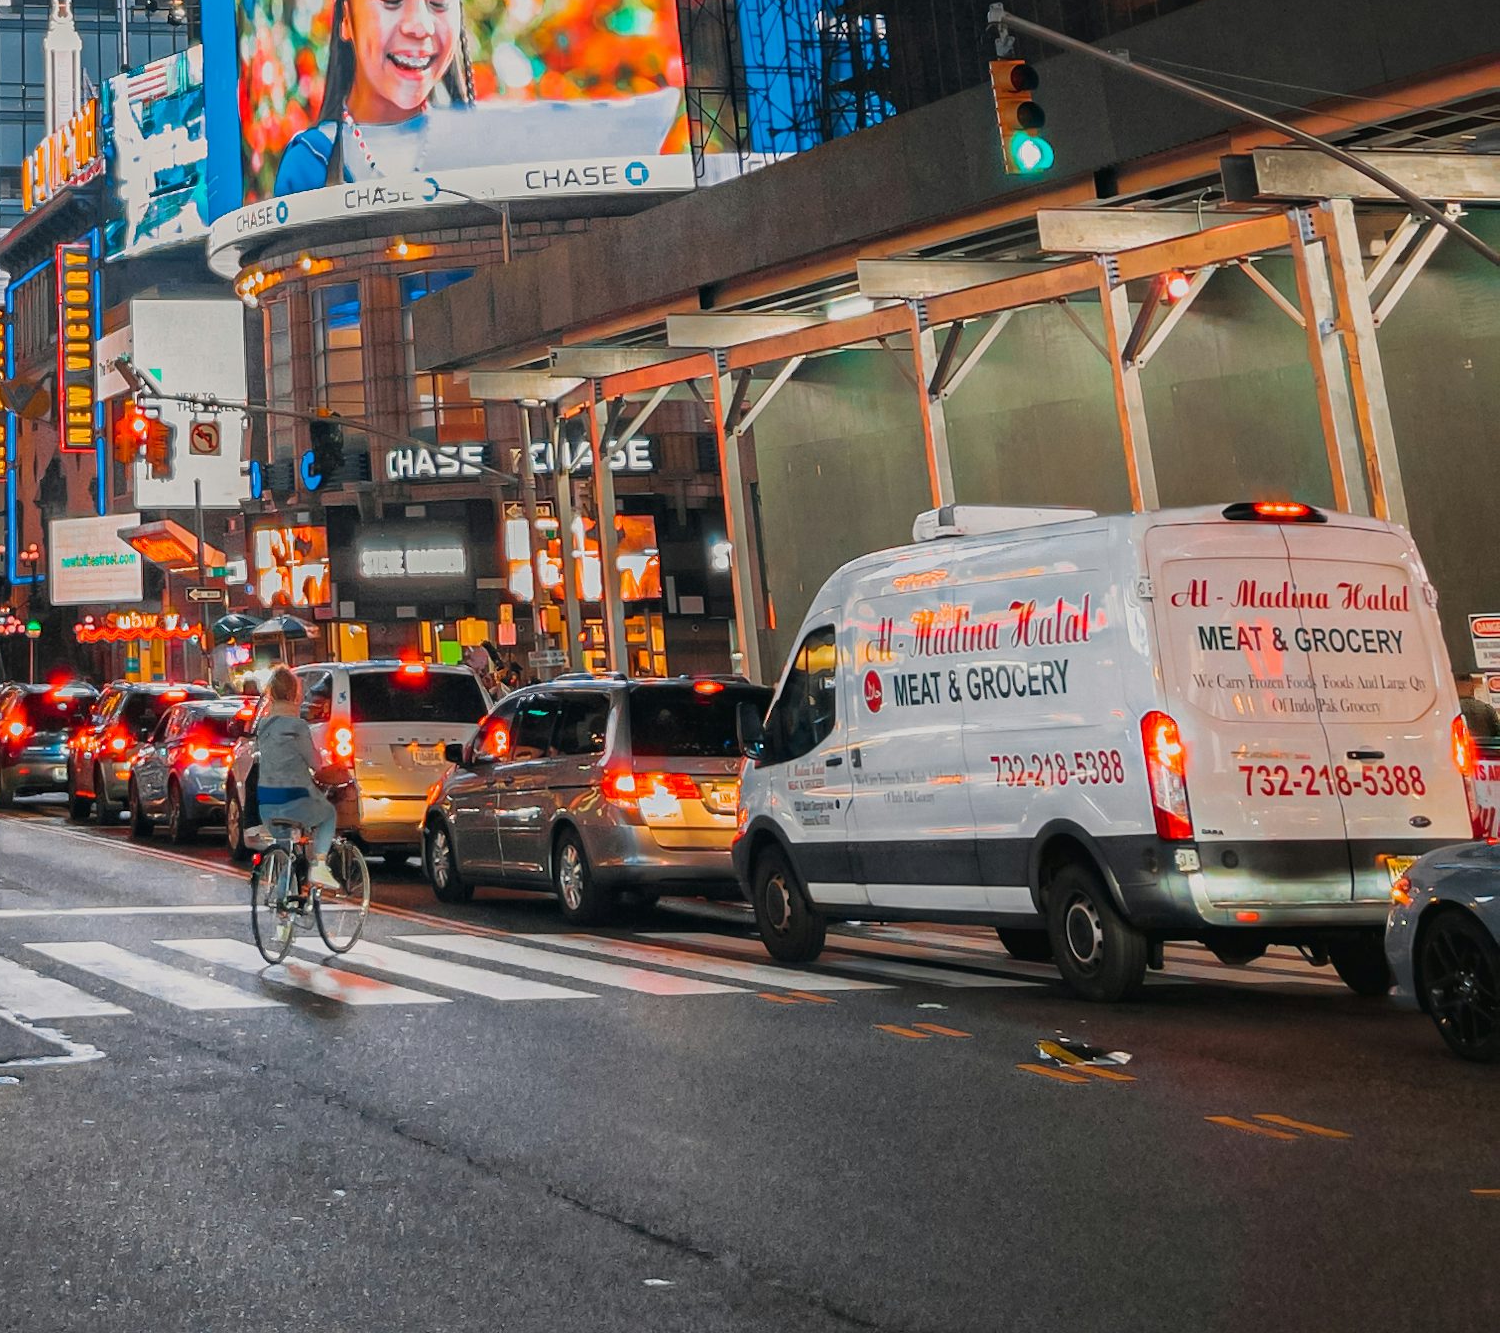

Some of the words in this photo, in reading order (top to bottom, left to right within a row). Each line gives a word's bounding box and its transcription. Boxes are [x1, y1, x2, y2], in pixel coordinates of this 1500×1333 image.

[525, 165, 618, 189] CHASE
[236, 205, 276, 234] CHASE
[64, 252, 93, 373] VICTORY
[66, 385, 94, 446] NEW
[385, 445, 485, 480] CHASE
[1171, 579, 1209, 607] Al
[1230, 579, 1331, 609] Madina
[1337, 582, 1411, 612] Halal
[866, 617, 894, 663] Al
[909, 609, 1000, 658] Madina
[1008, 593, 1092, 649] Halal
[1197, 625, 1263, 652] MEAT
[1272, 626, 1289, 653] &
[1295, 628, 1403, 654] GROCERY
[893, 671, 941, 707] MEAT
[949, 670, 963, 703] &
[966, 659, 1069, 702] GROCERY
[1192, 673, 1214, 689] We
[1216, 674, 1245, 691] Carry
[1248, 674, 1284, 689] Frozen
[1286, 674, 1316, 690] Foods
[1322, 674, 1355, 690] Foods
[1357, 674, 1378, 690] And
[1379, 675, 1408, 692] Large
[1289, 697, 1317, 713] Indo
[1317, 697, 1339, 714] Pak
[1339, 698, 1382, 715] Grocery
[990, 749, 1125, 788] 732-218-5388
[1238, 764, 1427, 796] 732-218-5388
